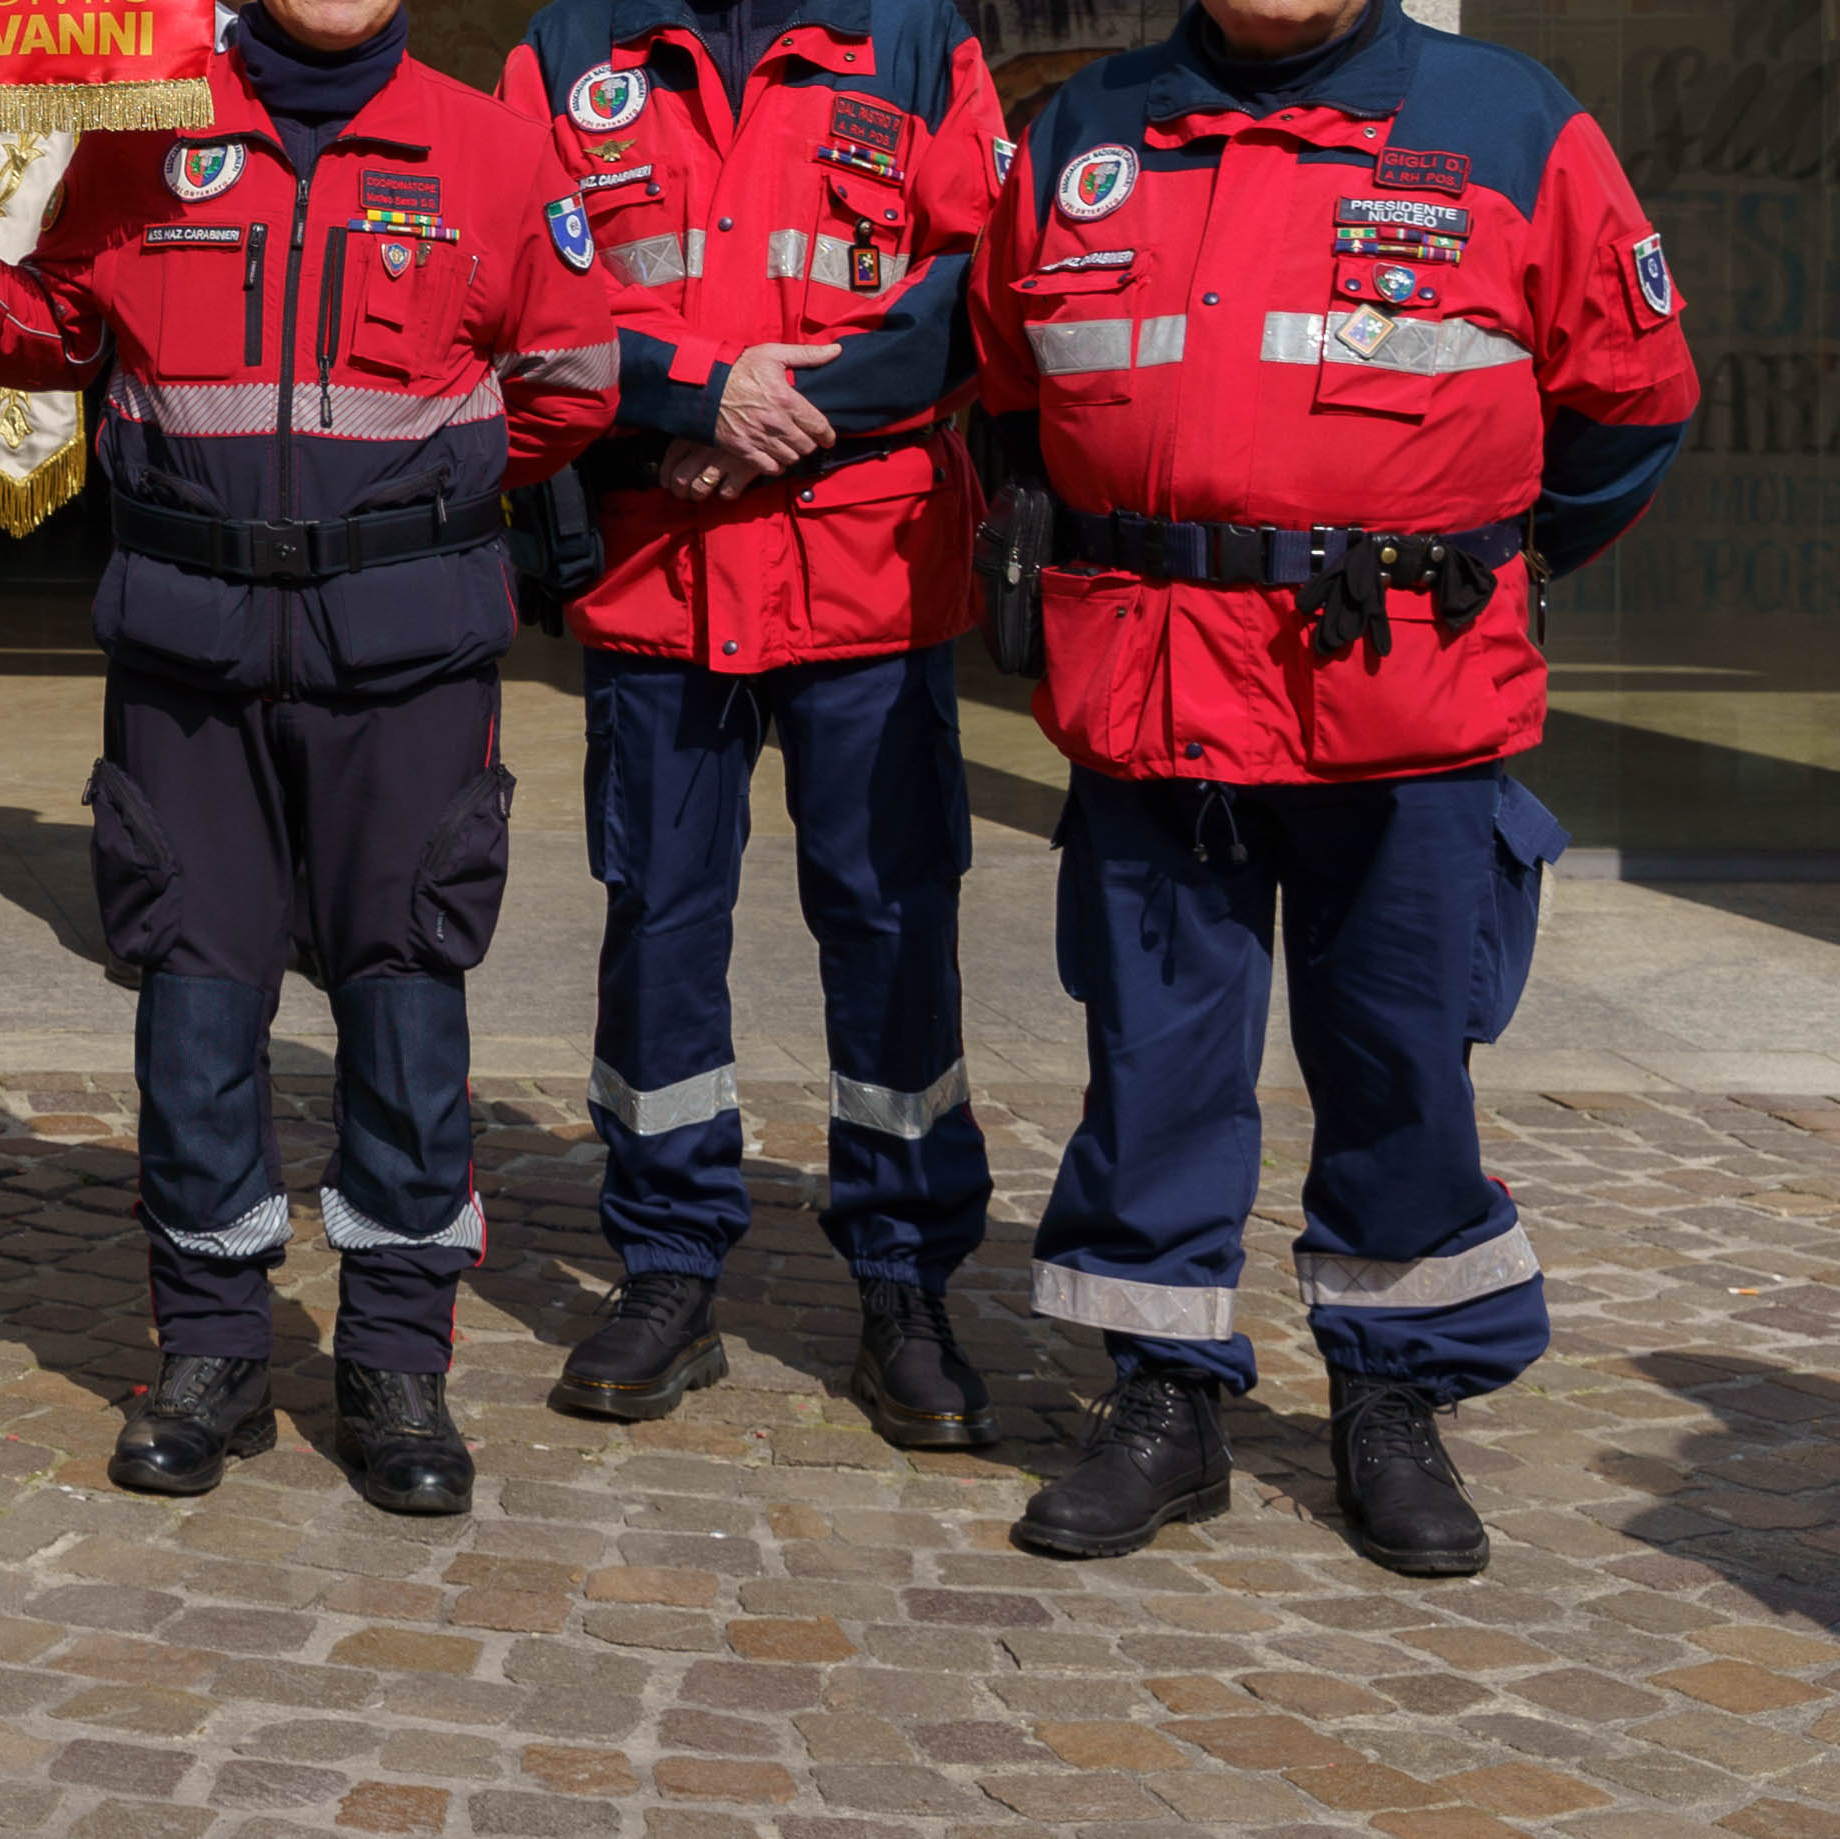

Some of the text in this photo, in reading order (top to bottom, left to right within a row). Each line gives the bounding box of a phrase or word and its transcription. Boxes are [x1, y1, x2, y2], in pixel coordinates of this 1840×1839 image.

[1384, 152, 1437, 169] GIGLI
[1384, 170, 1395, 180] A
[1399, 172, 1420, 182] RH
[1350, 200, 1458, 221] PRESIDENTE
[1367, 210, 1438, 228] NUCLEO
[184, 228, 241, 242] CARABINIERI
